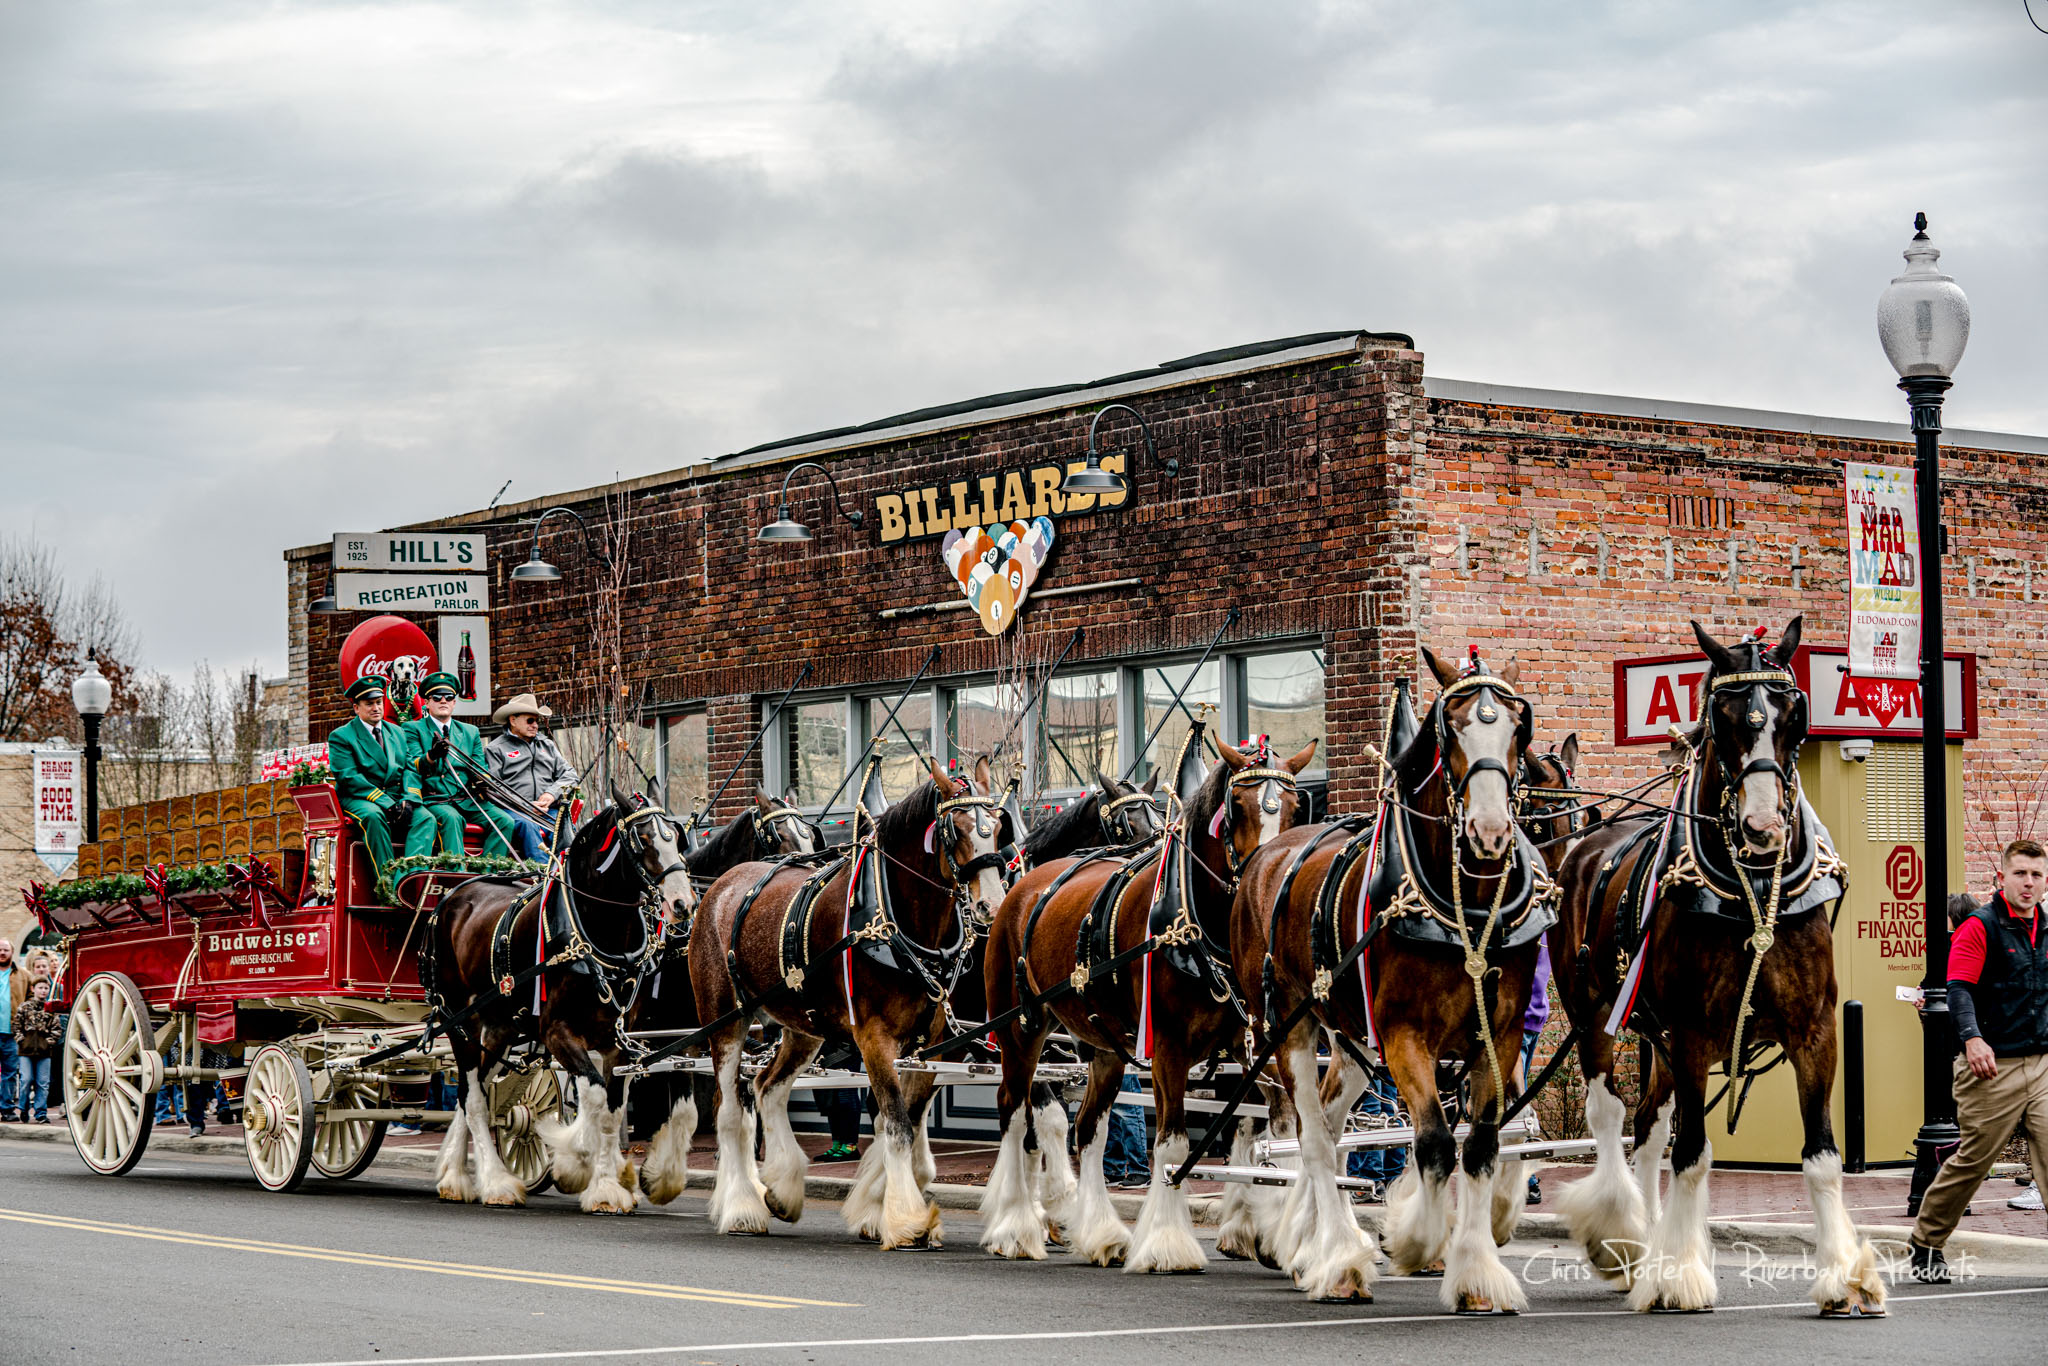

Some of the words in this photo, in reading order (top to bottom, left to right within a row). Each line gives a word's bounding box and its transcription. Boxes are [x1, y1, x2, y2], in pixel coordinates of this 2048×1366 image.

[348, 541, 368, 551] EST.
[390, 540, 473, 563] HILL'S
[347, 552, 368, 561] 1925
[988, 549, 997, 561] 8
[1855, 549, 1915, 587] MAD
[1012, 574, 1020, 585] 11
[358, 580, 468, 605] RECREATION
[434, 599, 479, 609] PARLOR
[1857, 615, 1918, 628] ELDOMAD.COM
[1873, 631, 1898, 646] MAD
[41, 787, 72, 803] GOOD
[40, 804, 77, 822] TIME.
[1880, 902, 1926, 919] FIRST
[1880, 940, 1927, 957] BANK
[1911, 963, 1923, 971] FDIC
